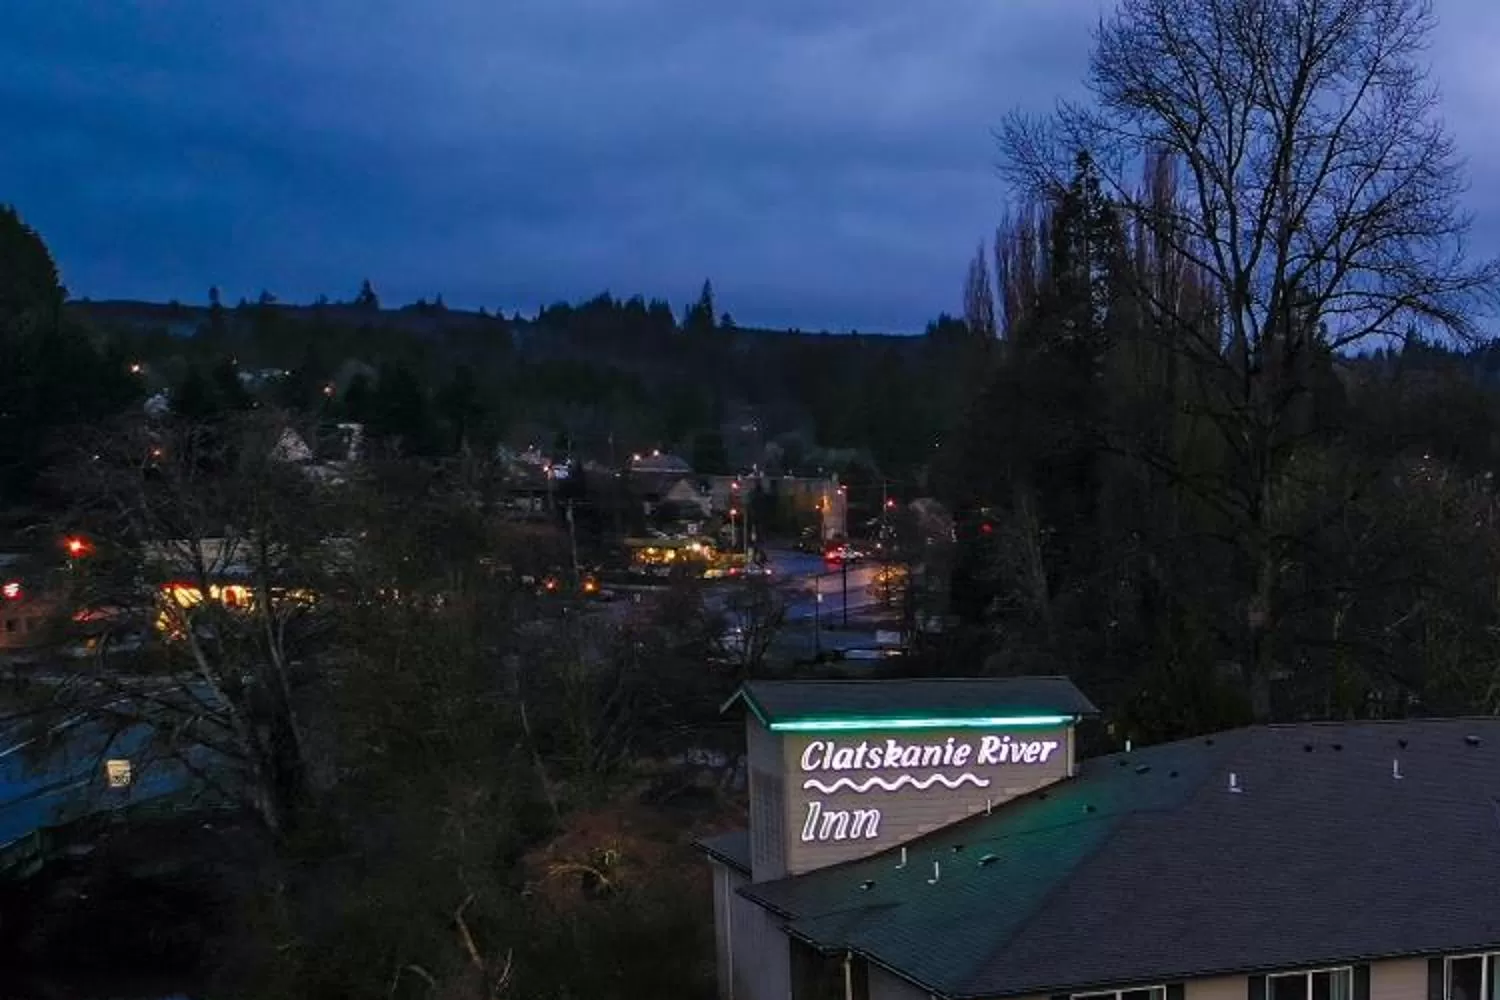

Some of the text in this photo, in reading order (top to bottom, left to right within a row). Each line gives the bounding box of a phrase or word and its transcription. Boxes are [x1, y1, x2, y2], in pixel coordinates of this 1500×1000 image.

[801, 735, 1058, 771] Clatskanie River
[801, 801, 881, 842] Inn
